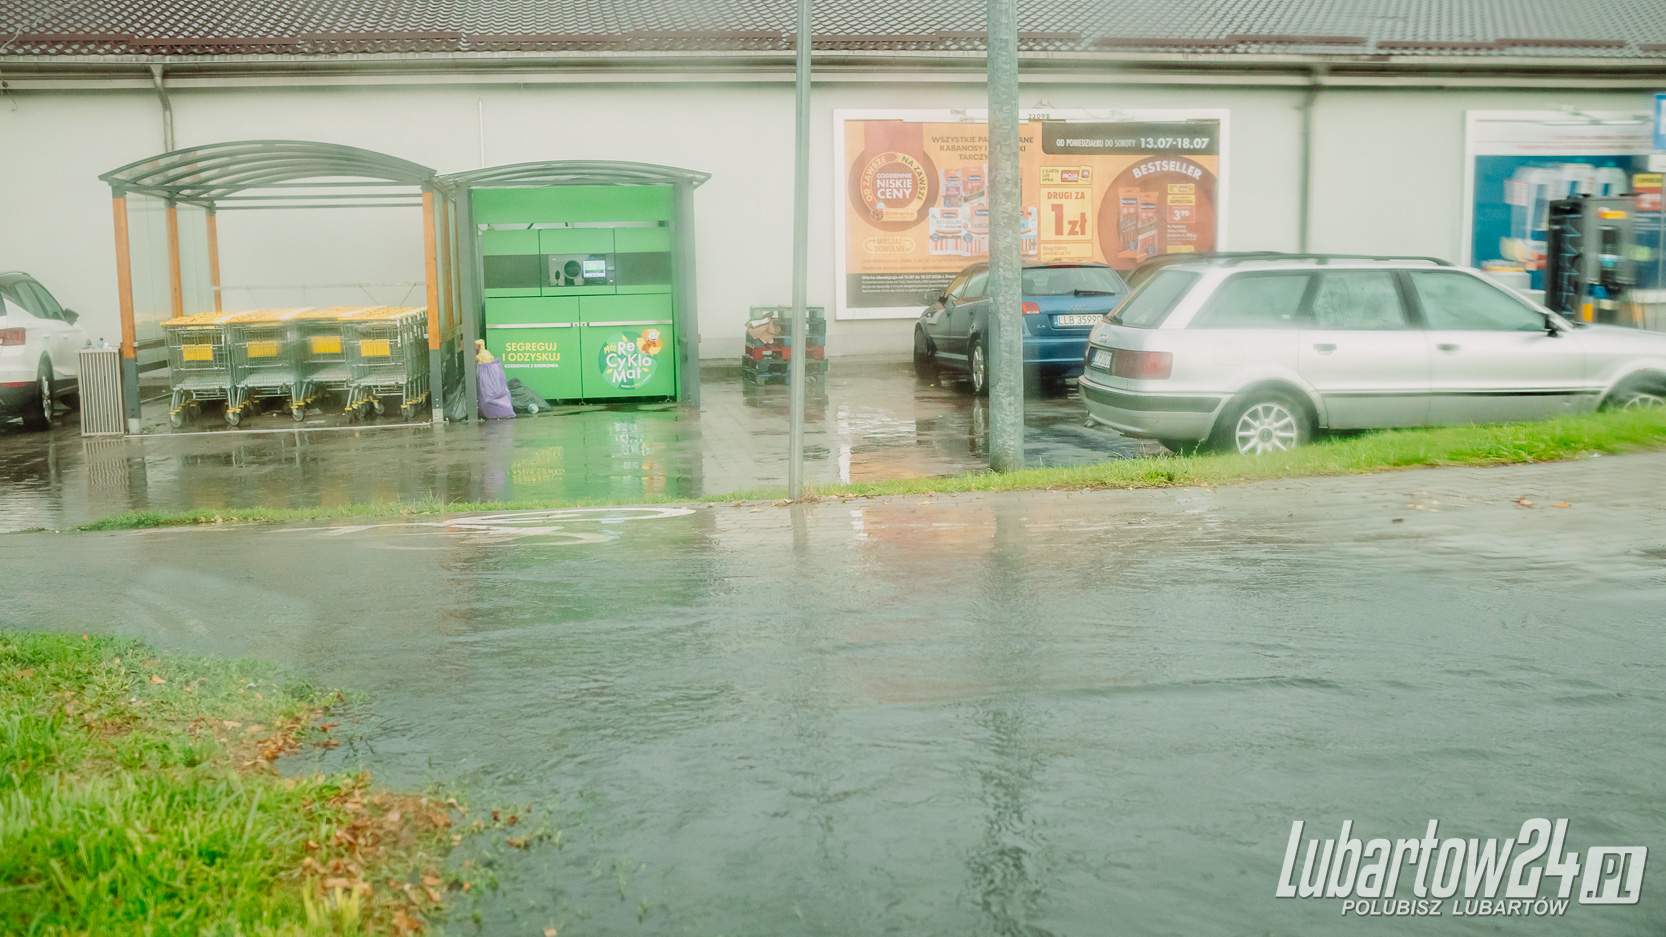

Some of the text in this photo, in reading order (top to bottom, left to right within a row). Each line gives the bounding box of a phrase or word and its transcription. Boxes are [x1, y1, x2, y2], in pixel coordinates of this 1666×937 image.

[1056, 139, 1065, 147] OD
[1105, 139, 1113, 147] DO
[1140, 138, 1210, 149] 13.07-18.07
[1132, 160, 1202, 180] BESTSELLER
[877, 179, 912, 188] NISKIE
[901, 156, 926, 201] NA ZAWSZE
[877, 188, 912, 199] CENY
[1047, 191, 1085, 200] DRUGI ZA
[505, 342, 557, 352] SEGREGUJ
[508, 353, 560, 362] ODZYSKUJ
